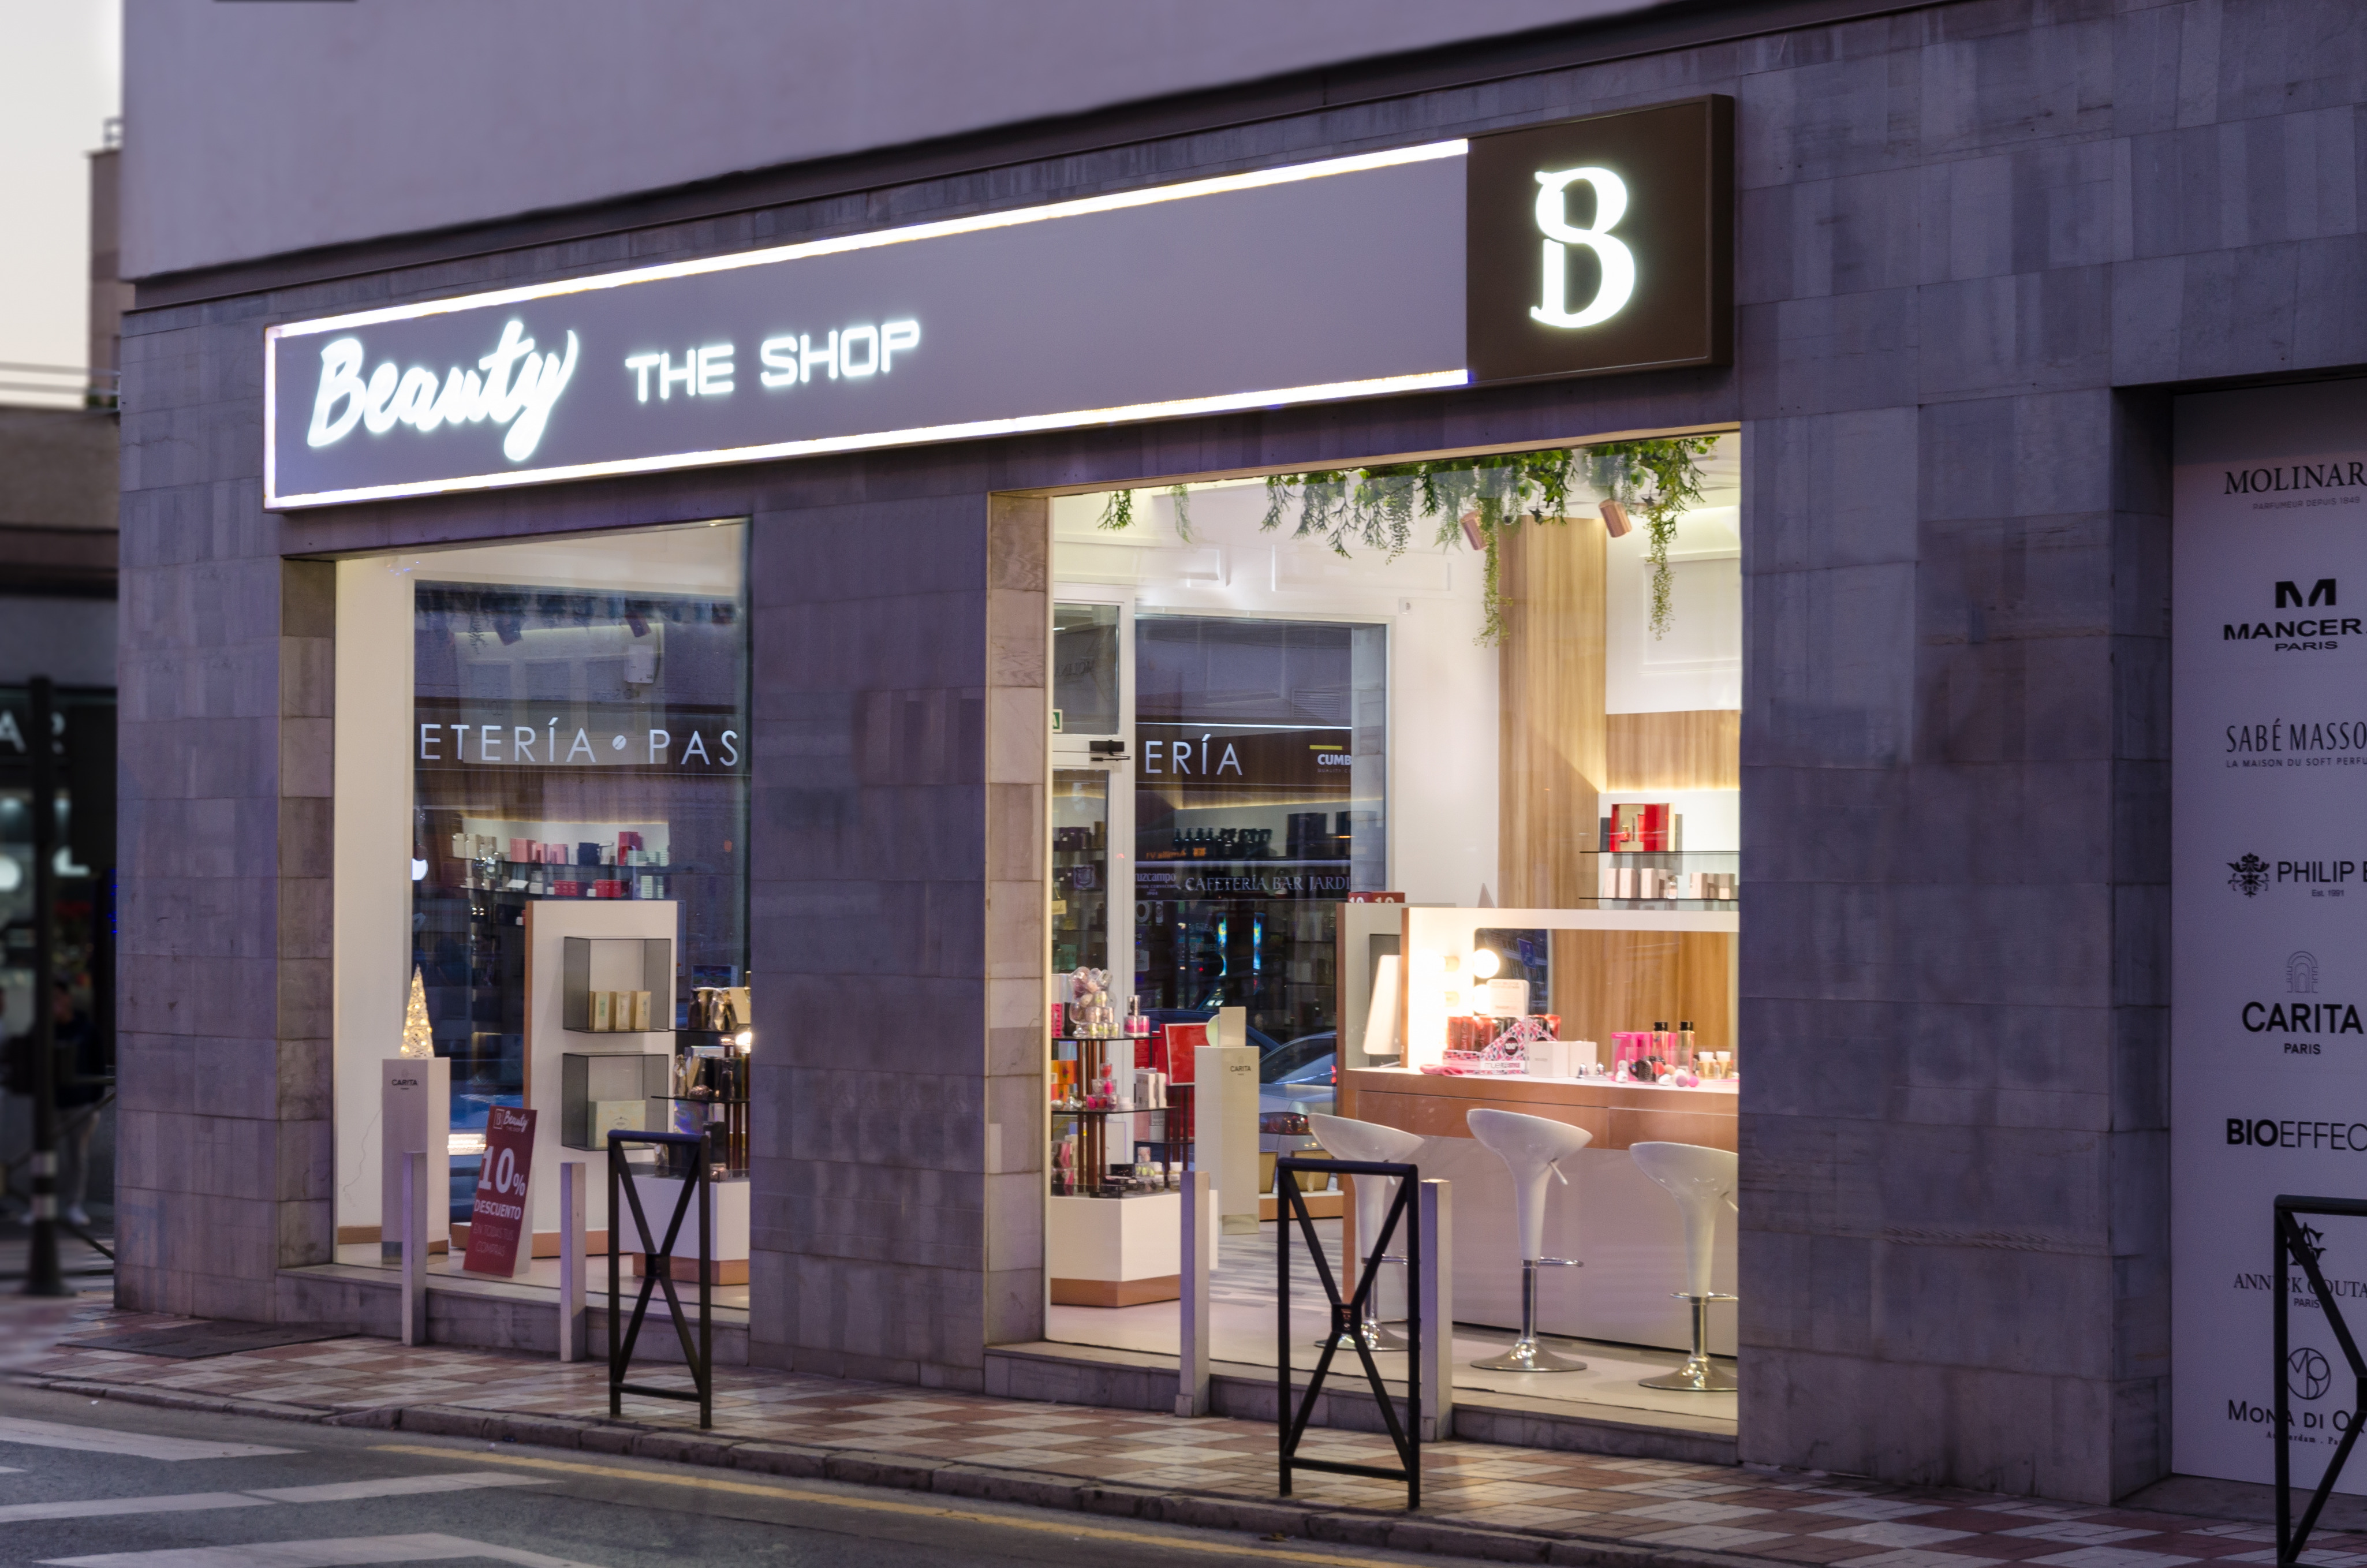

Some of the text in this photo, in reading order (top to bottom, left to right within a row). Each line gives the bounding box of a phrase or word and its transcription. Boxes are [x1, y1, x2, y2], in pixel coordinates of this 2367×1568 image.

[1530, 167, 1635, 328] B
[307, 319, 920, 461] Beauty THE SHOP
[2224, 462, 2367, 494] MOLINAR
[2306, 498, 2337, 507] DEPUIS
[2224, 618, 2367, 640] MANCER
[2275, 641, 2338, 651] PARIS
[420, 717, 739, 767] ETERÍA PAS
[2226, 718, 2367, 753] SABÉ MASSO
[1145, 733, 1243, 775] ERÍA
[1317, 753, 1351, 766] CUMB
[2226, 760, 2238, 768] LA
[2242, 759, 2283, 767] MAISON
[2287, 759, 2302, 767] DU
[2306, 757, 2332, 766] SOFT
[1185, 875, 1268, 891] CAFETERÍA
[1272, 877, 1303, 890] BAR
[2278, 861, 2355, 883] PHILIP
[2328, 889, 2344, 897] 1991
[2242, 1002, 2364, 1035] CARITA
[2284, 1043, 2321, 1055] PARIS
[503, 1110, 529, 1133] Beauty
[478, 1145, 525, 1196] 10%
[474, 1199, 521, 1220] DESCUENTO
[2234, 1274, 2302, 1293] ANNK
[2294, 1297, 2320, 1308] PARIS
[2304, 1412, 2323, 1429] DI
[2332, 1410, 2364, 1433] O
